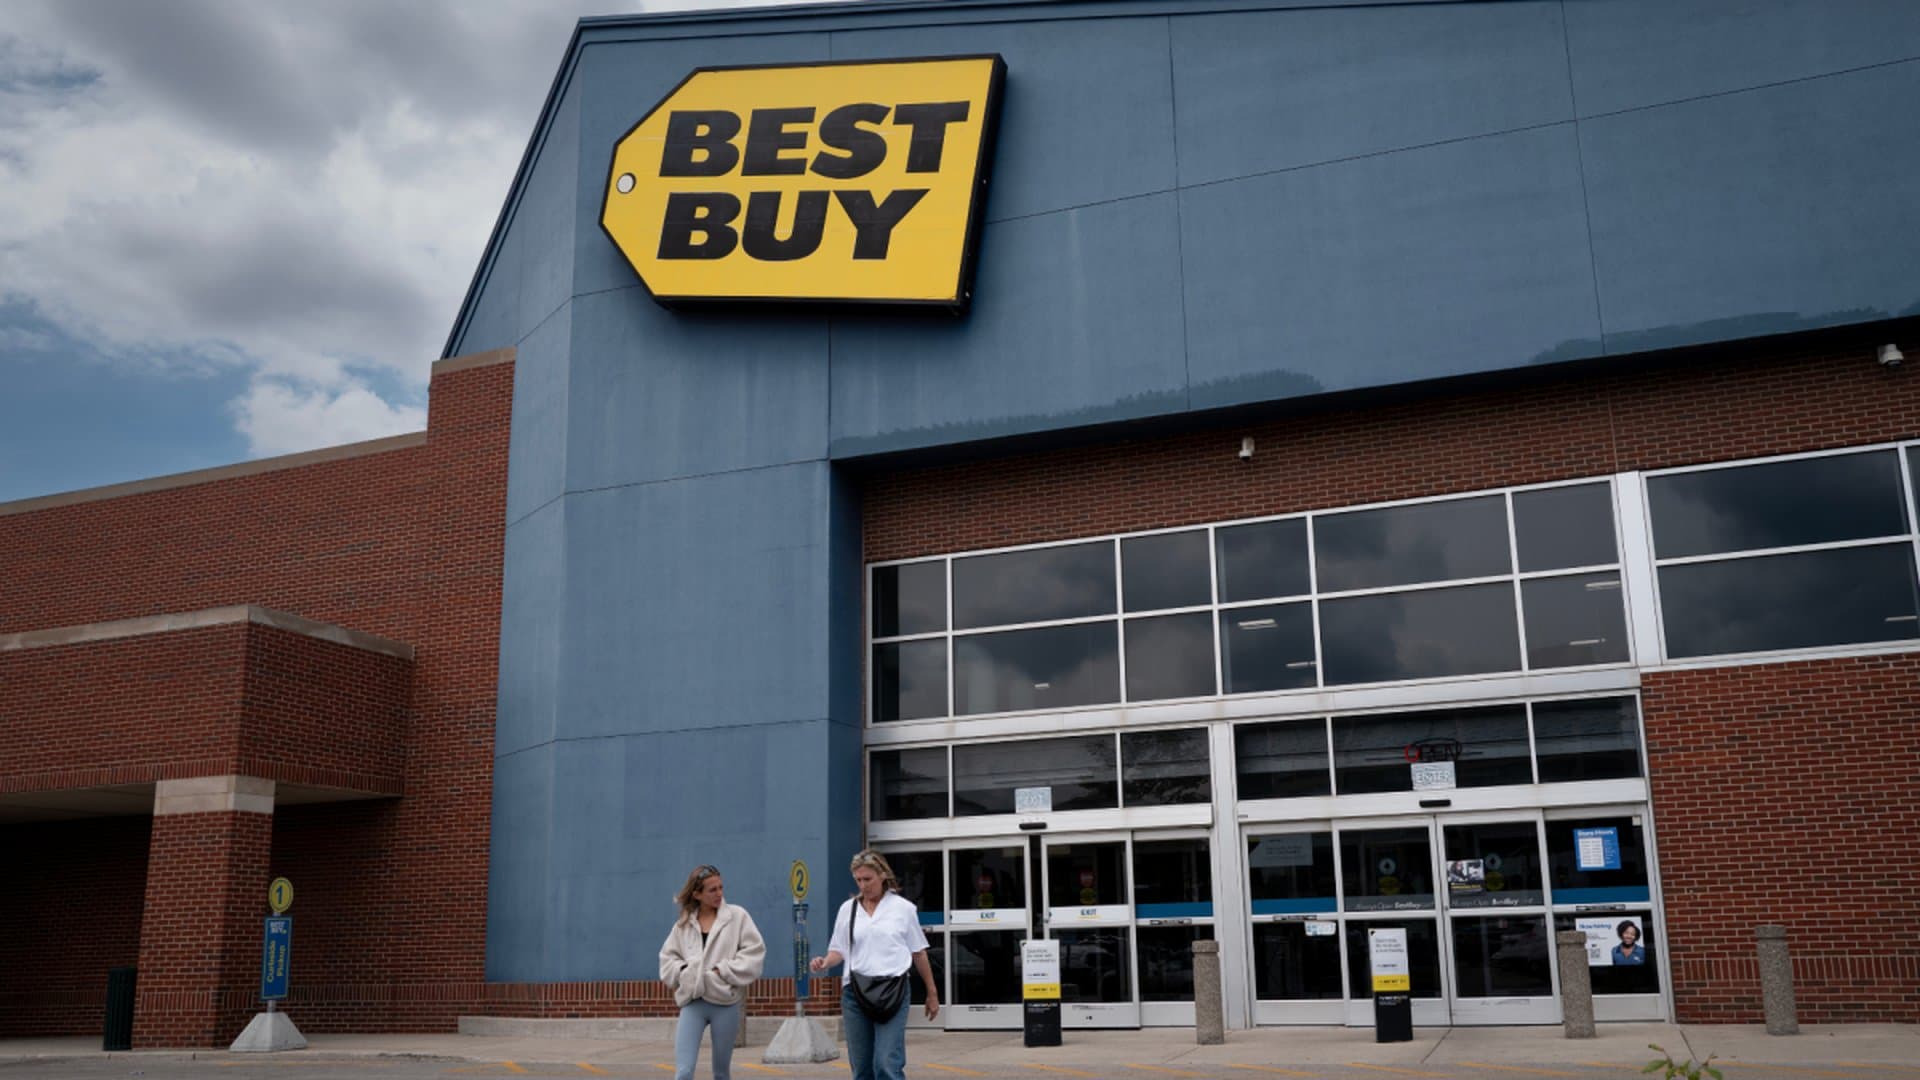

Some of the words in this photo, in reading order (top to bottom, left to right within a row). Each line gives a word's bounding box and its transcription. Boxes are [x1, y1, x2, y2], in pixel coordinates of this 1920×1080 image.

[659, 100, 971, 180] BEST
[656, 188, 931, 262] BUY
[796, 869, 804, 892] 2
[276, 885, 283, 905] 1
[980, 911, 995, 920] EXIT
[1081, 908, 1096, 916] EXIT
[267, 940, 276, 983] Curbside
[276, 945, 286, 977] Pickup
